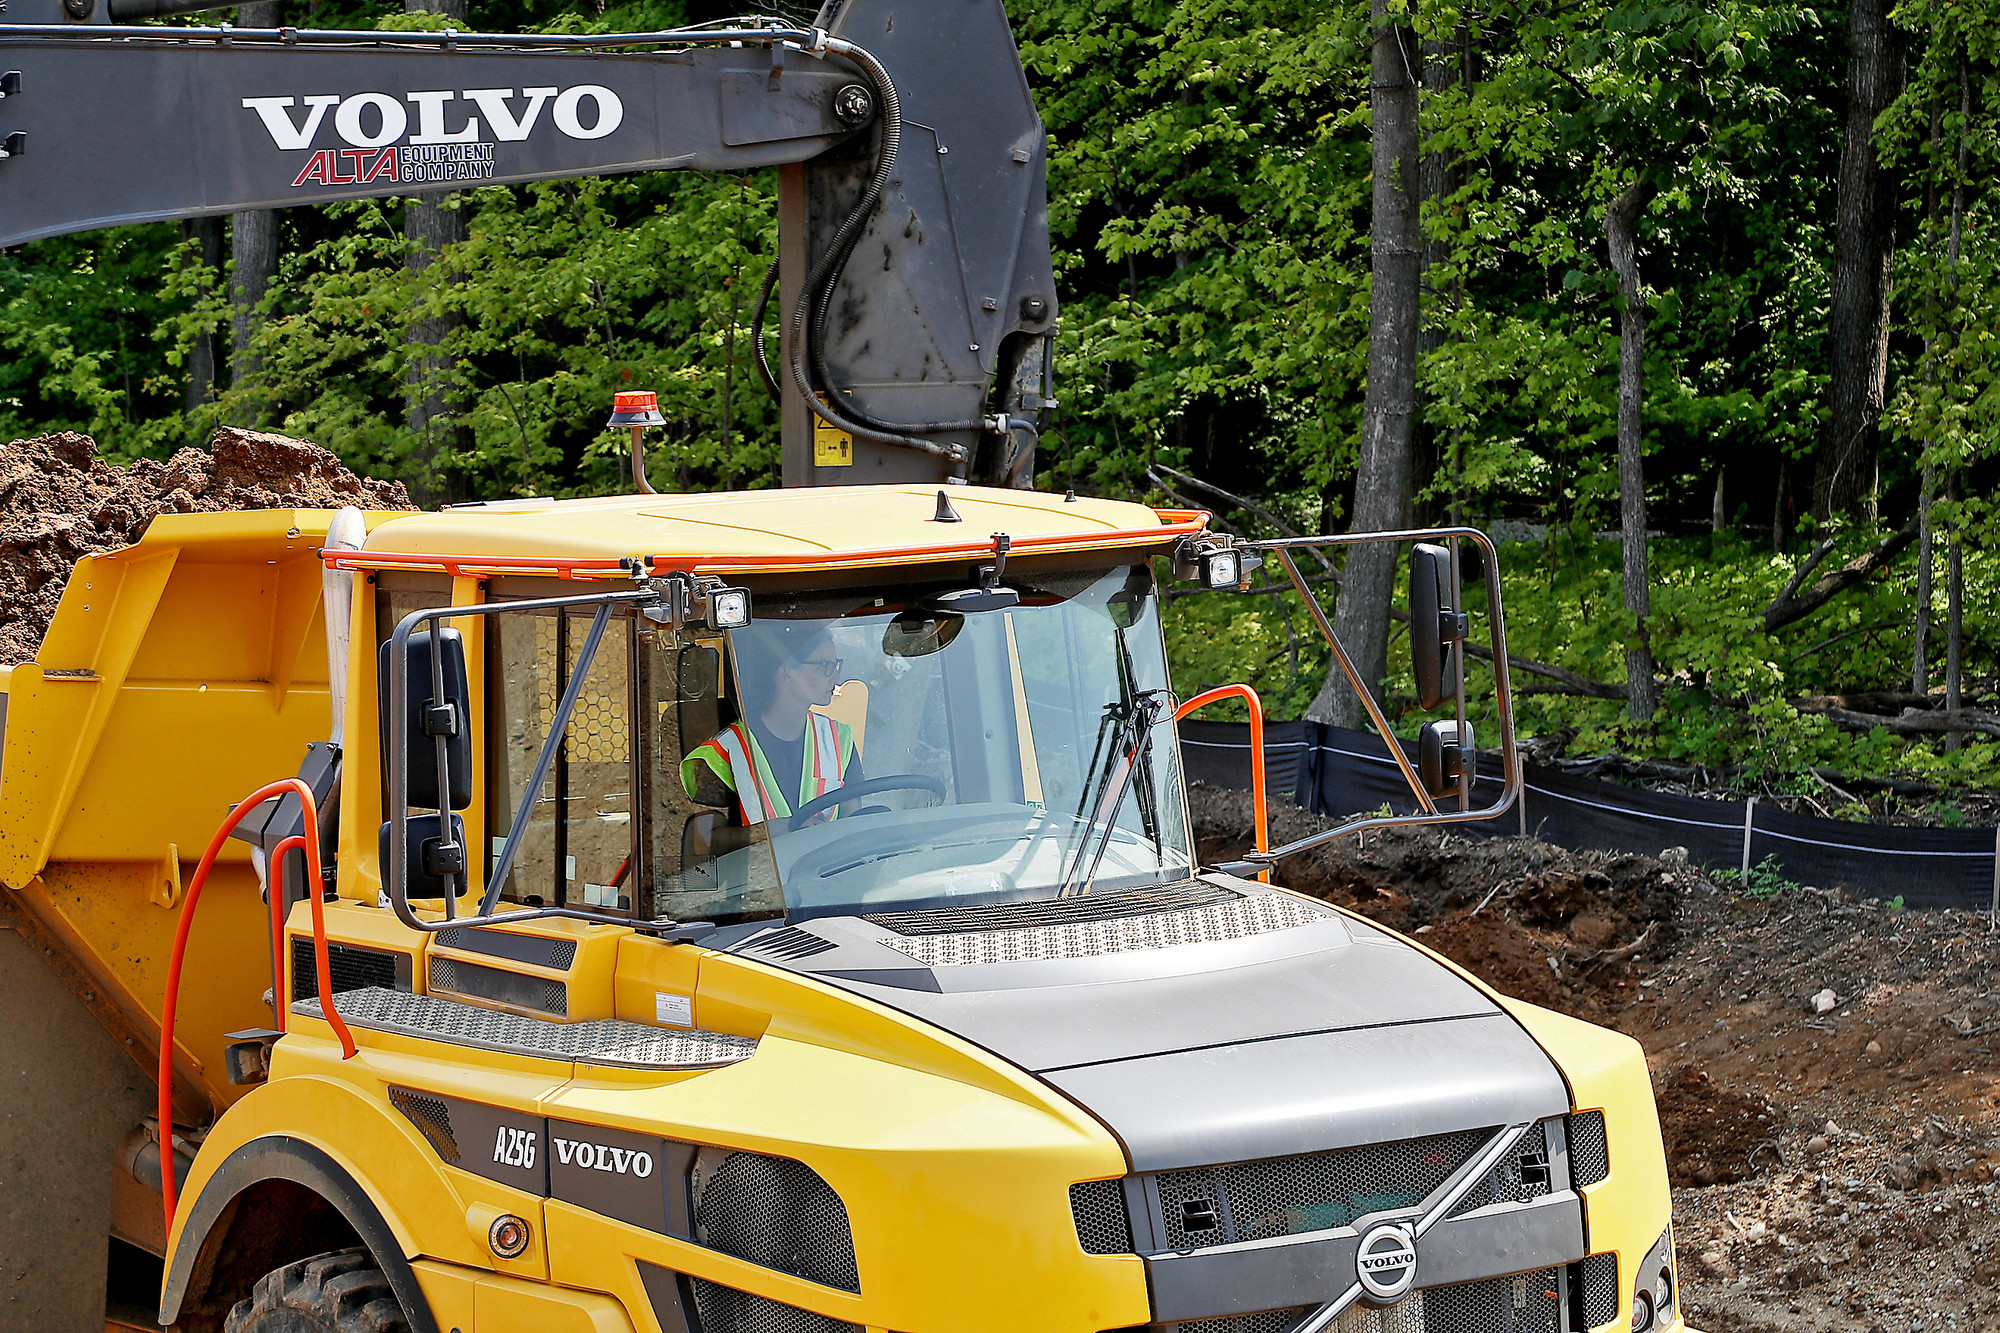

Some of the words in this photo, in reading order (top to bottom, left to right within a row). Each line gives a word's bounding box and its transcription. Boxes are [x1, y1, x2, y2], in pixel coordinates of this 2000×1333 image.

[242, 85, 624, 150] VOLVO
[291, 147, 399, 187] ALTA
[400, 143, 495, 165] EQUIPMENT
[401, 160, 495, 182] COMPANY
[493, 1126, 536, 1169] A25G
[553, 1138, 653, 1178] VOLVO
[1360, 1253, 1414, 1269] VOLVO
